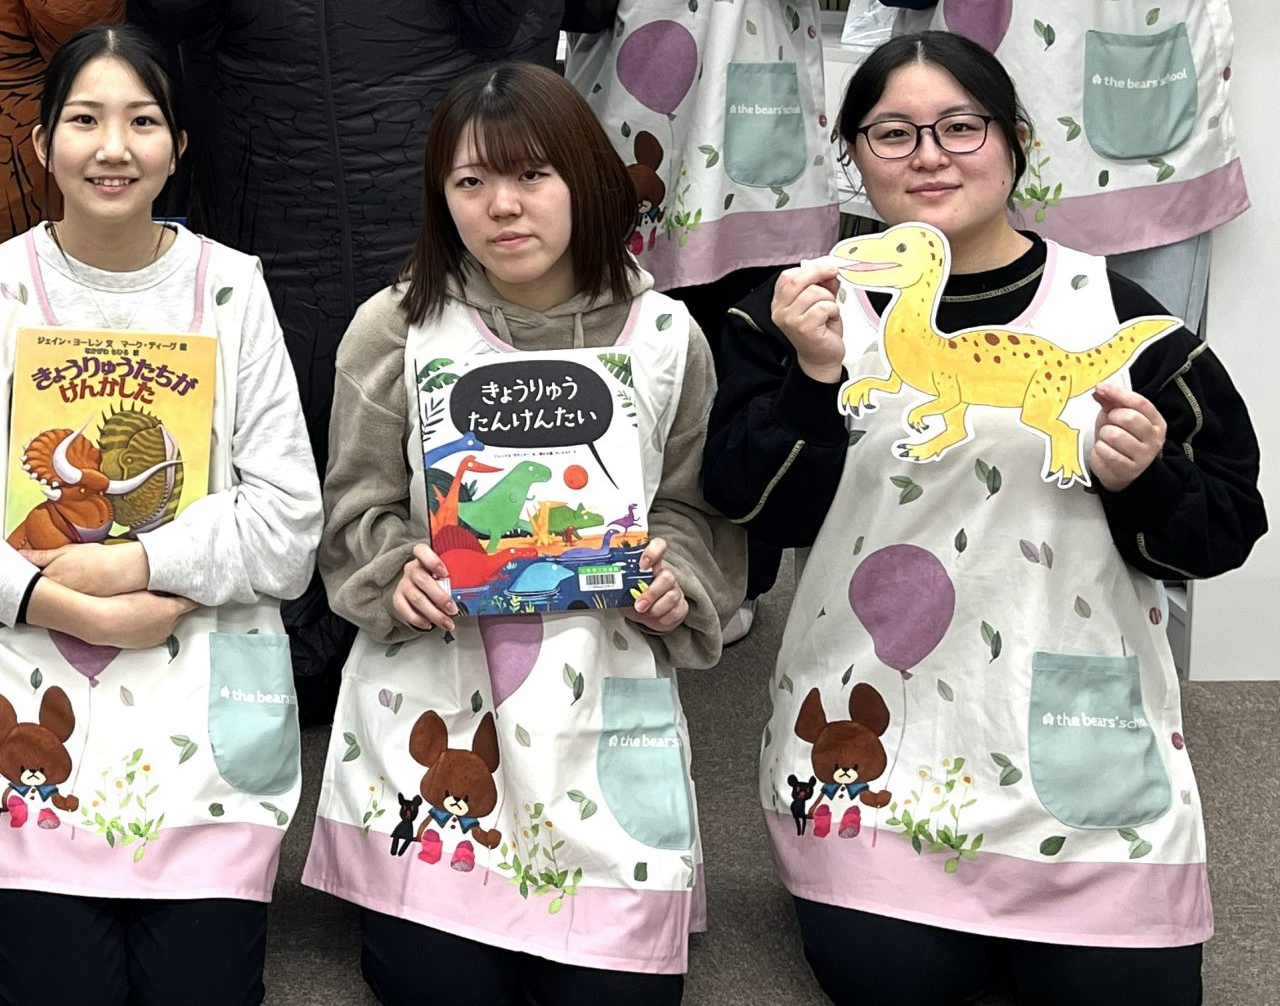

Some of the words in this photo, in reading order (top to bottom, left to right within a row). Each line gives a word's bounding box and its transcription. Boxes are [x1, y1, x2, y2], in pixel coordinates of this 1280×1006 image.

[1104, 75, 1125, 89] the
[737, 103, 754, 114] the
[37, 336, 103, 347] ジェイン・ヨーレン
[106, 339, 114, 348] 文
[31, 356, 199, 396] きょうりゅうたちが
[59, 376, 156, 404] けんかした
[481, 376, 578, 405] きょうりゅう
[468, 406, 597, 432] たんけんたい
[231, 688, 255, 703] the
[1056, 712, 1080, 727] the
[1081, 712, 1119, 728] bears'
[620, 734, 641, 747] the
